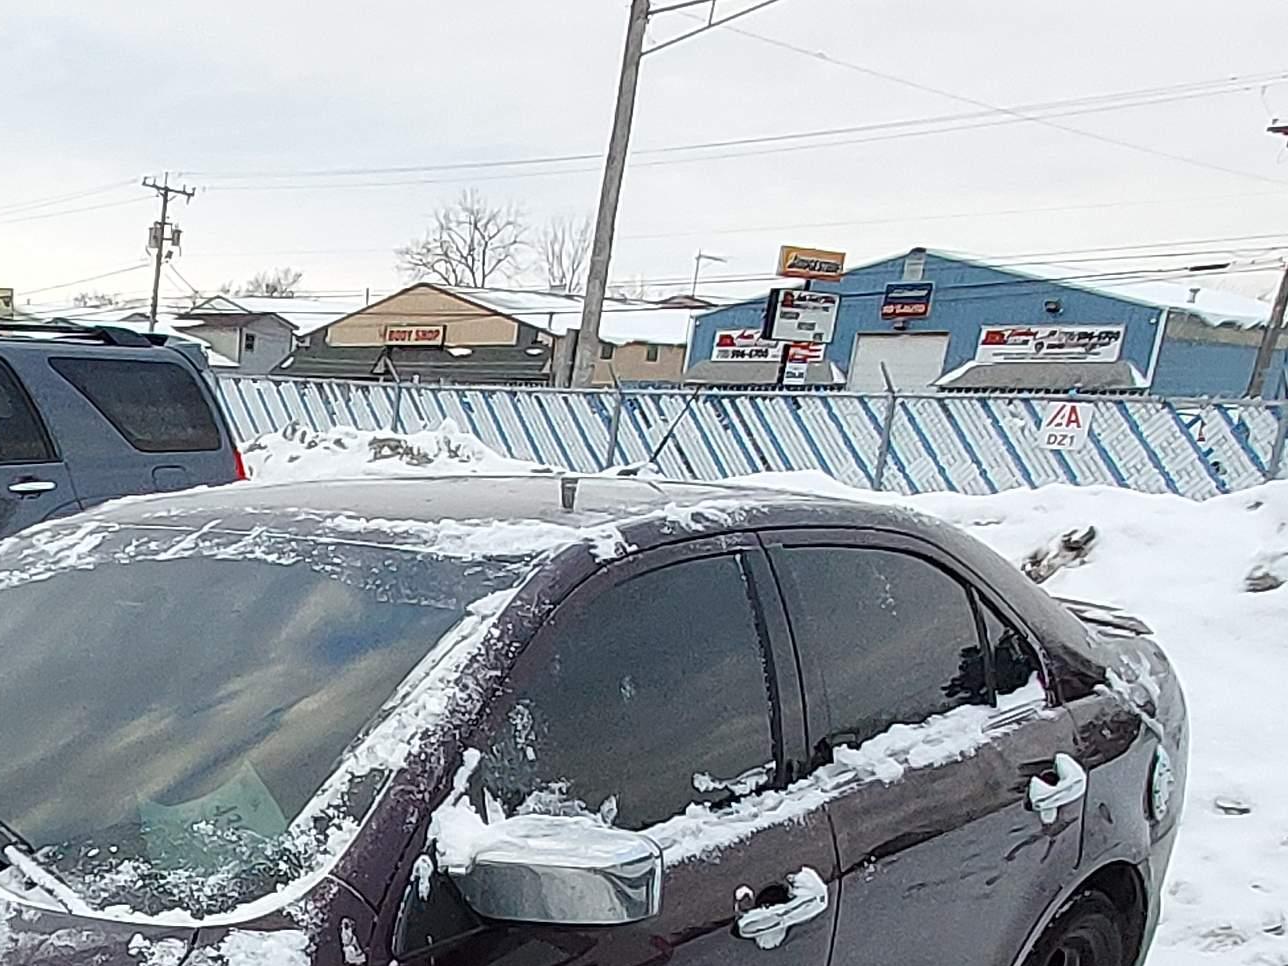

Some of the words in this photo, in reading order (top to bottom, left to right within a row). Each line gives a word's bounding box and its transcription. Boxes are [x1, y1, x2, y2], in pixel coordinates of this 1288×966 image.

[389, 329, 412, 341] BODY
[415, 329, 440, 341] SHOP
[1047, 433, 1075, 447] DZ1
